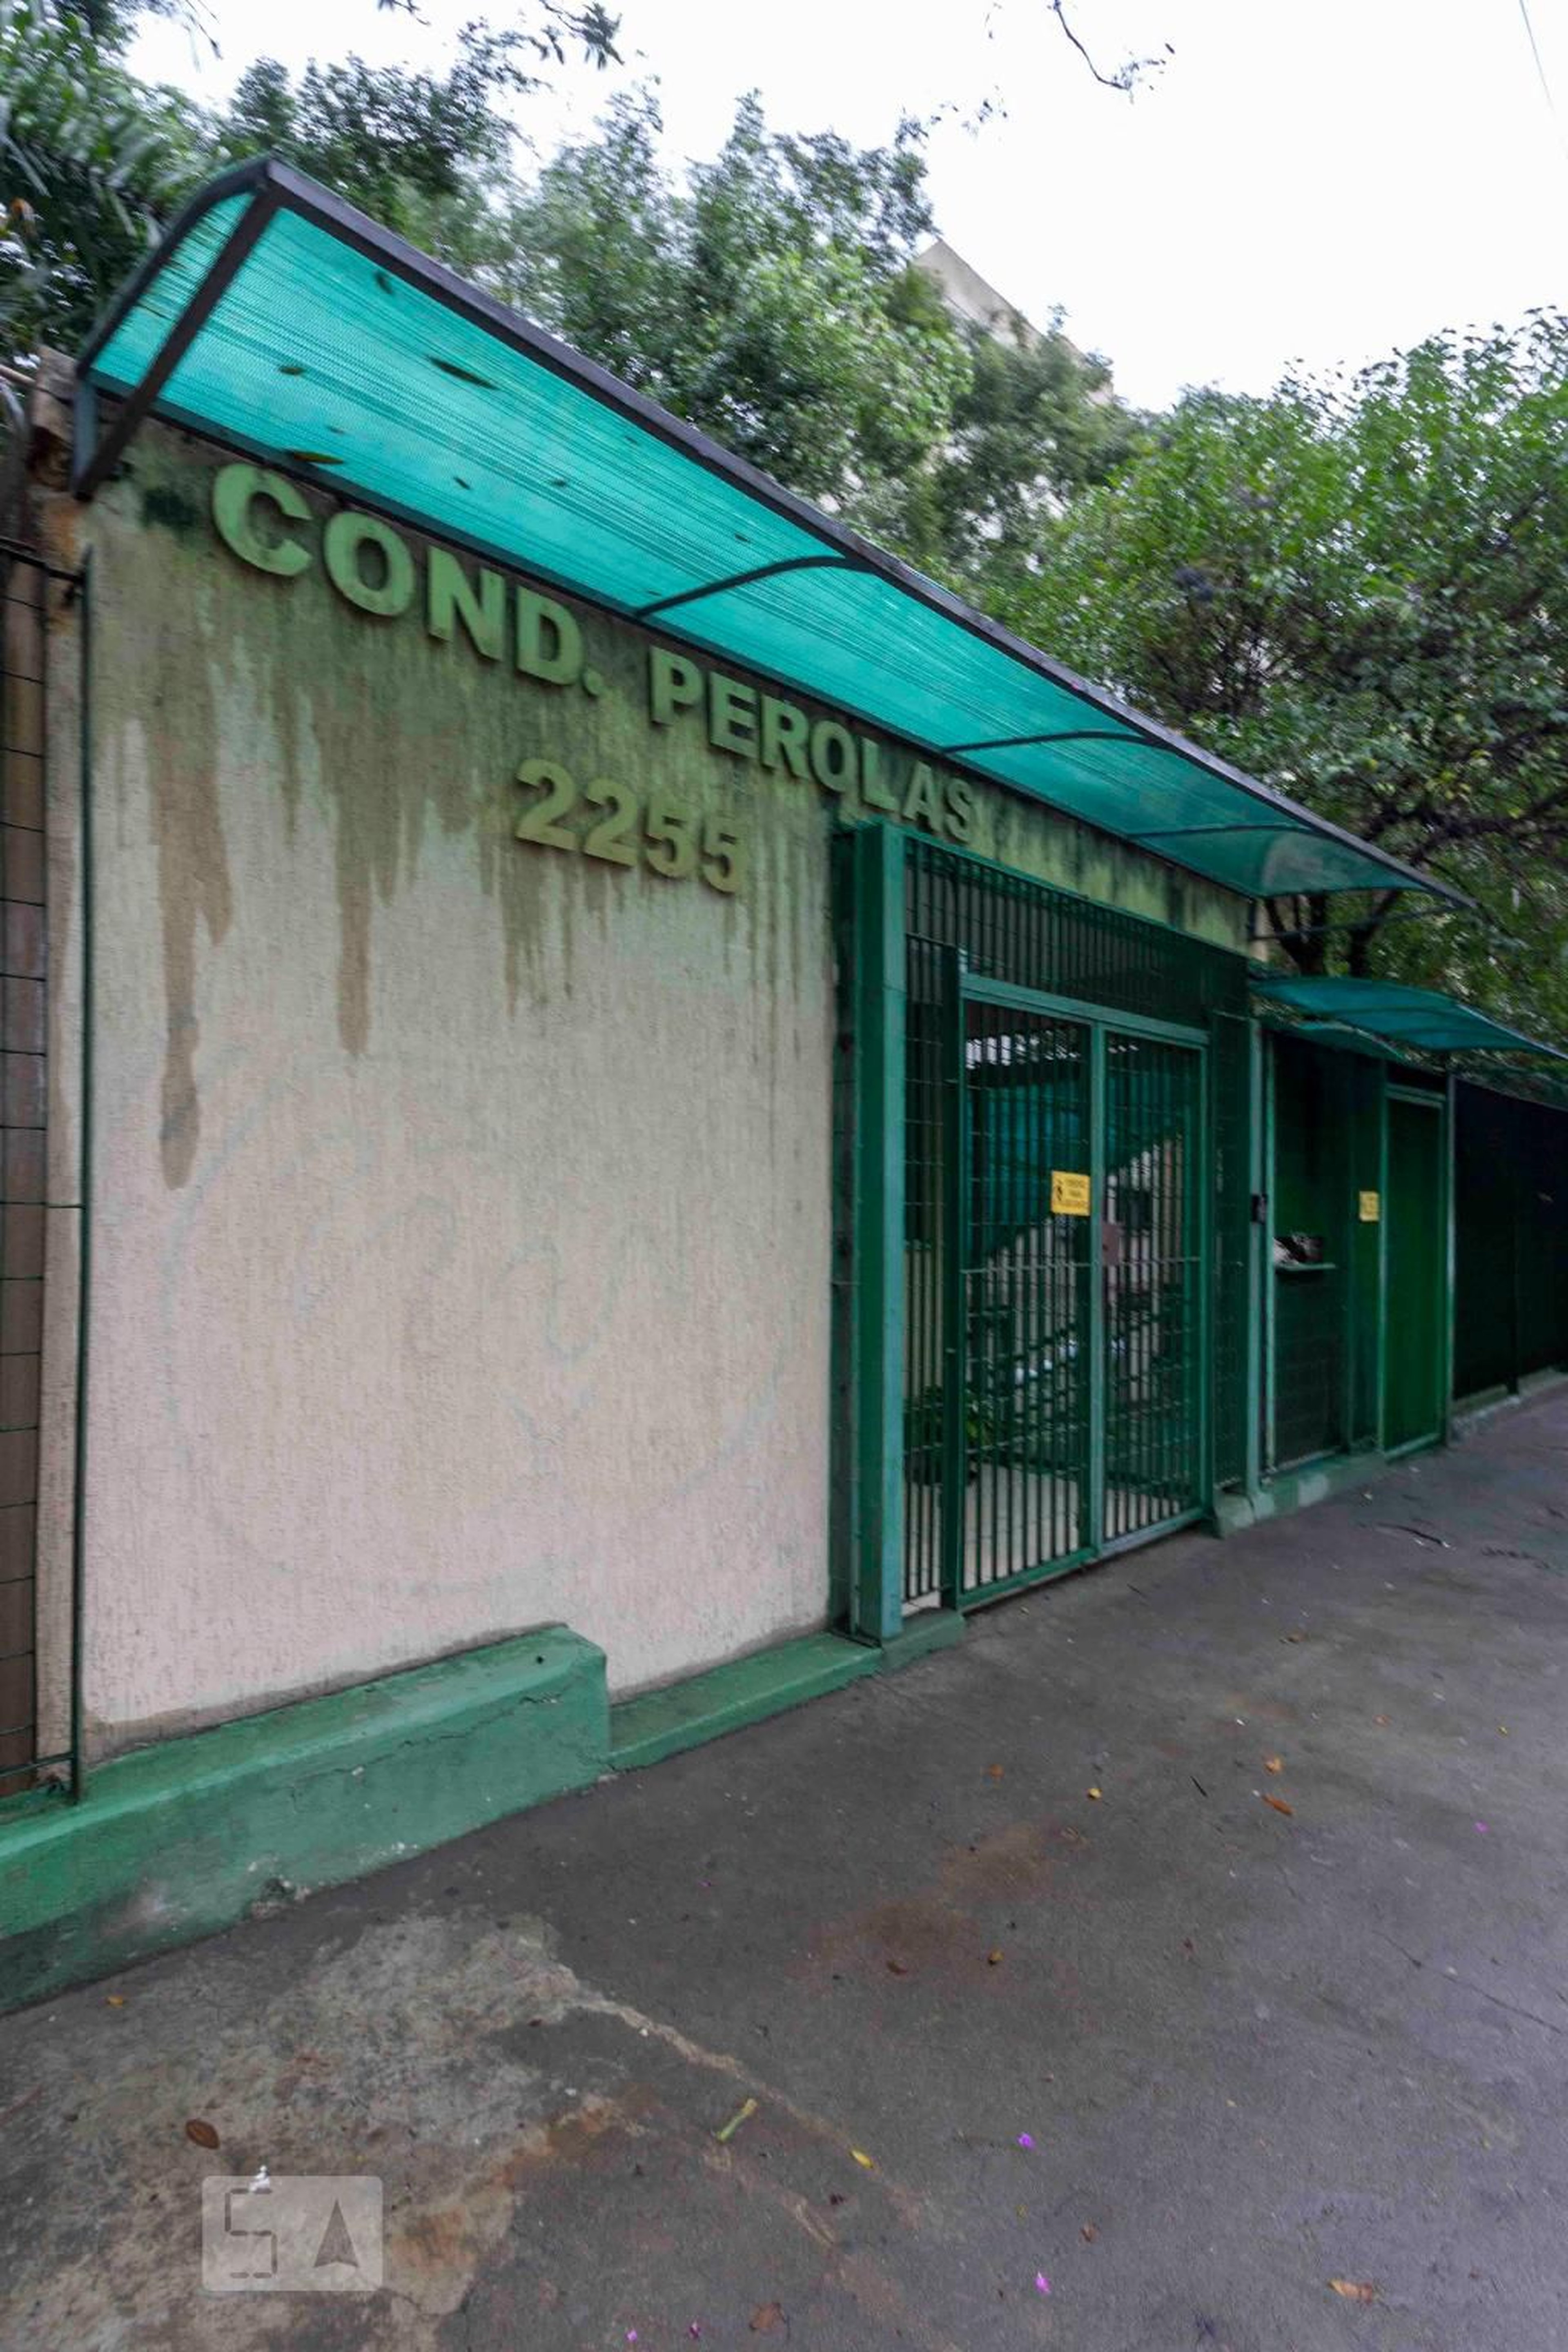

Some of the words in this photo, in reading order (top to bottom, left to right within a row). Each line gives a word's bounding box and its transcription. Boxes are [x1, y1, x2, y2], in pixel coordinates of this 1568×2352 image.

[212, 463, 604, 697] COND.
[649, 644, 974, 845] PEROLAS
[515, 758, 749, 893] 2255
